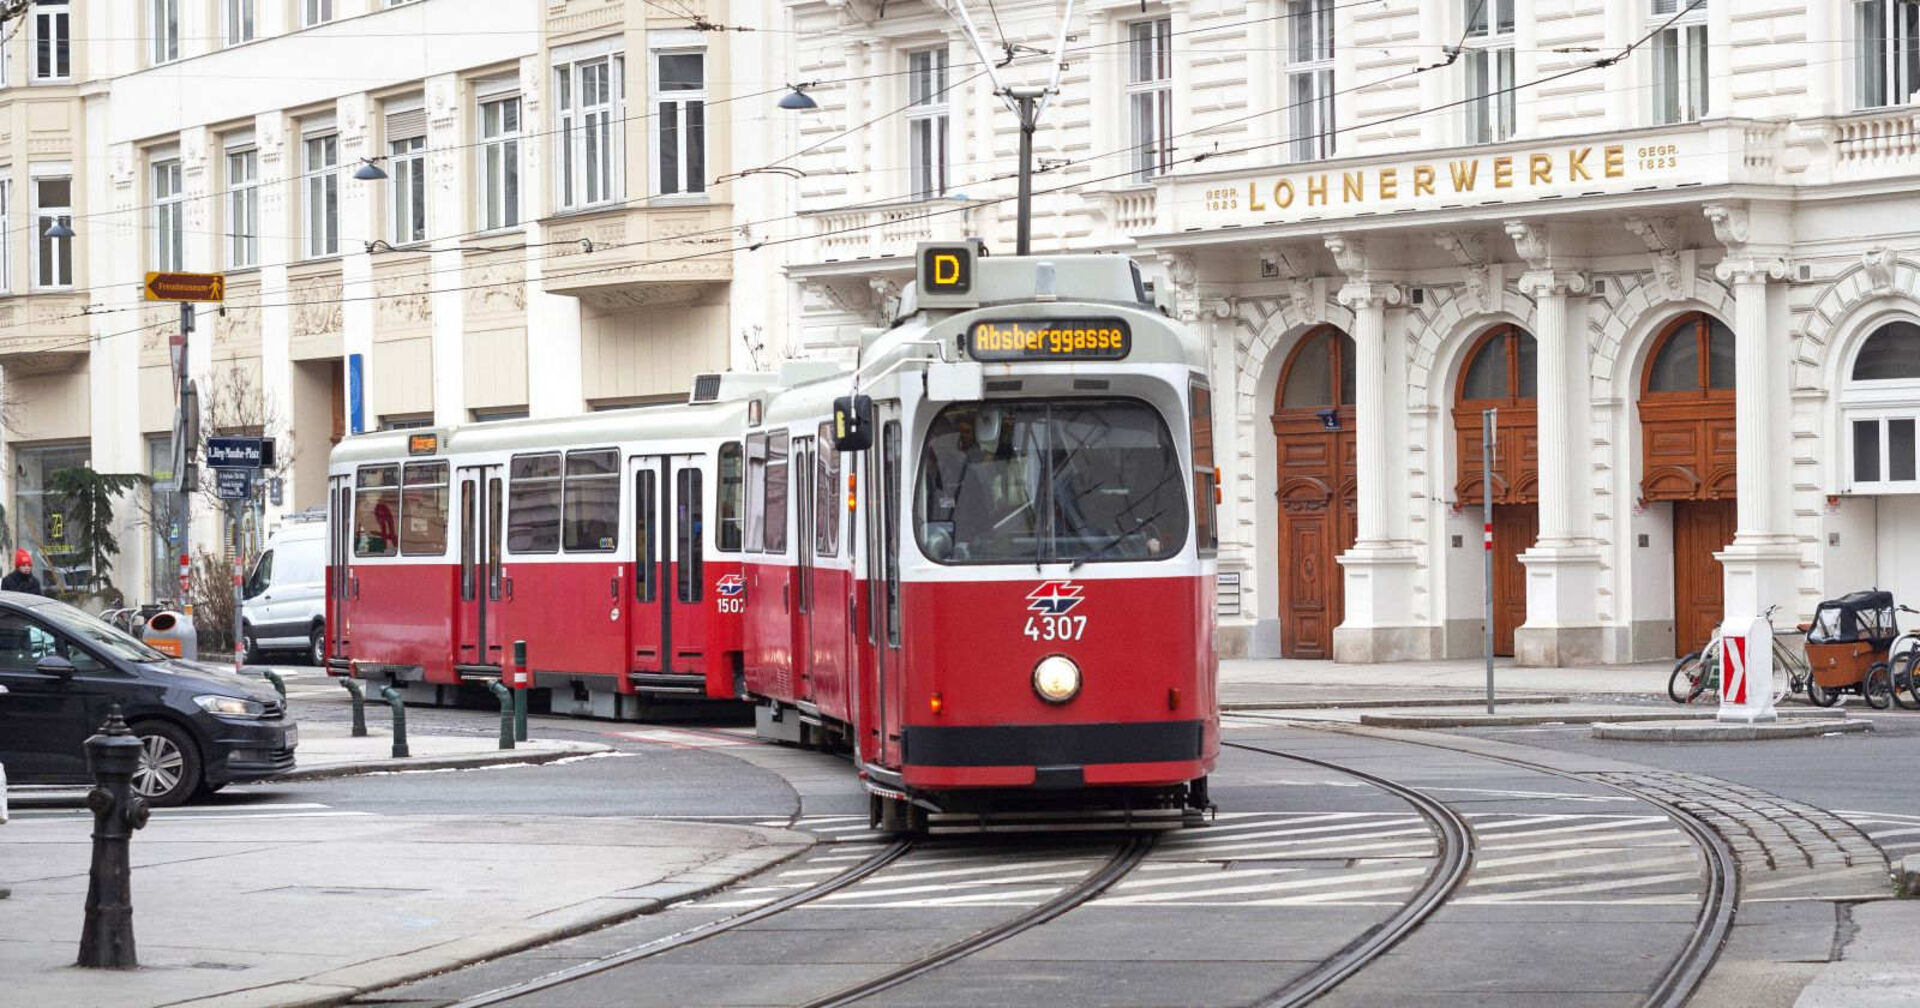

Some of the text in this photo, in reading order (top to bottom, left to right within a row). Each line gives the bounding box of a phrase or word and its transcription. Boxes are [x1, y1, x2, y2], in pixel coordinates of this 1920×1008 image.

[1638, 144, 1679, 158] GEGR.
[1638, 156, 1676, 170] 1823
[1249, 145, 1624, 211] LOHNERWERKE
[934, 253, 960, 285] D
[976, 323, 1123, 353] Absberggasse
[1023, 615, 1088, 642] 4307
